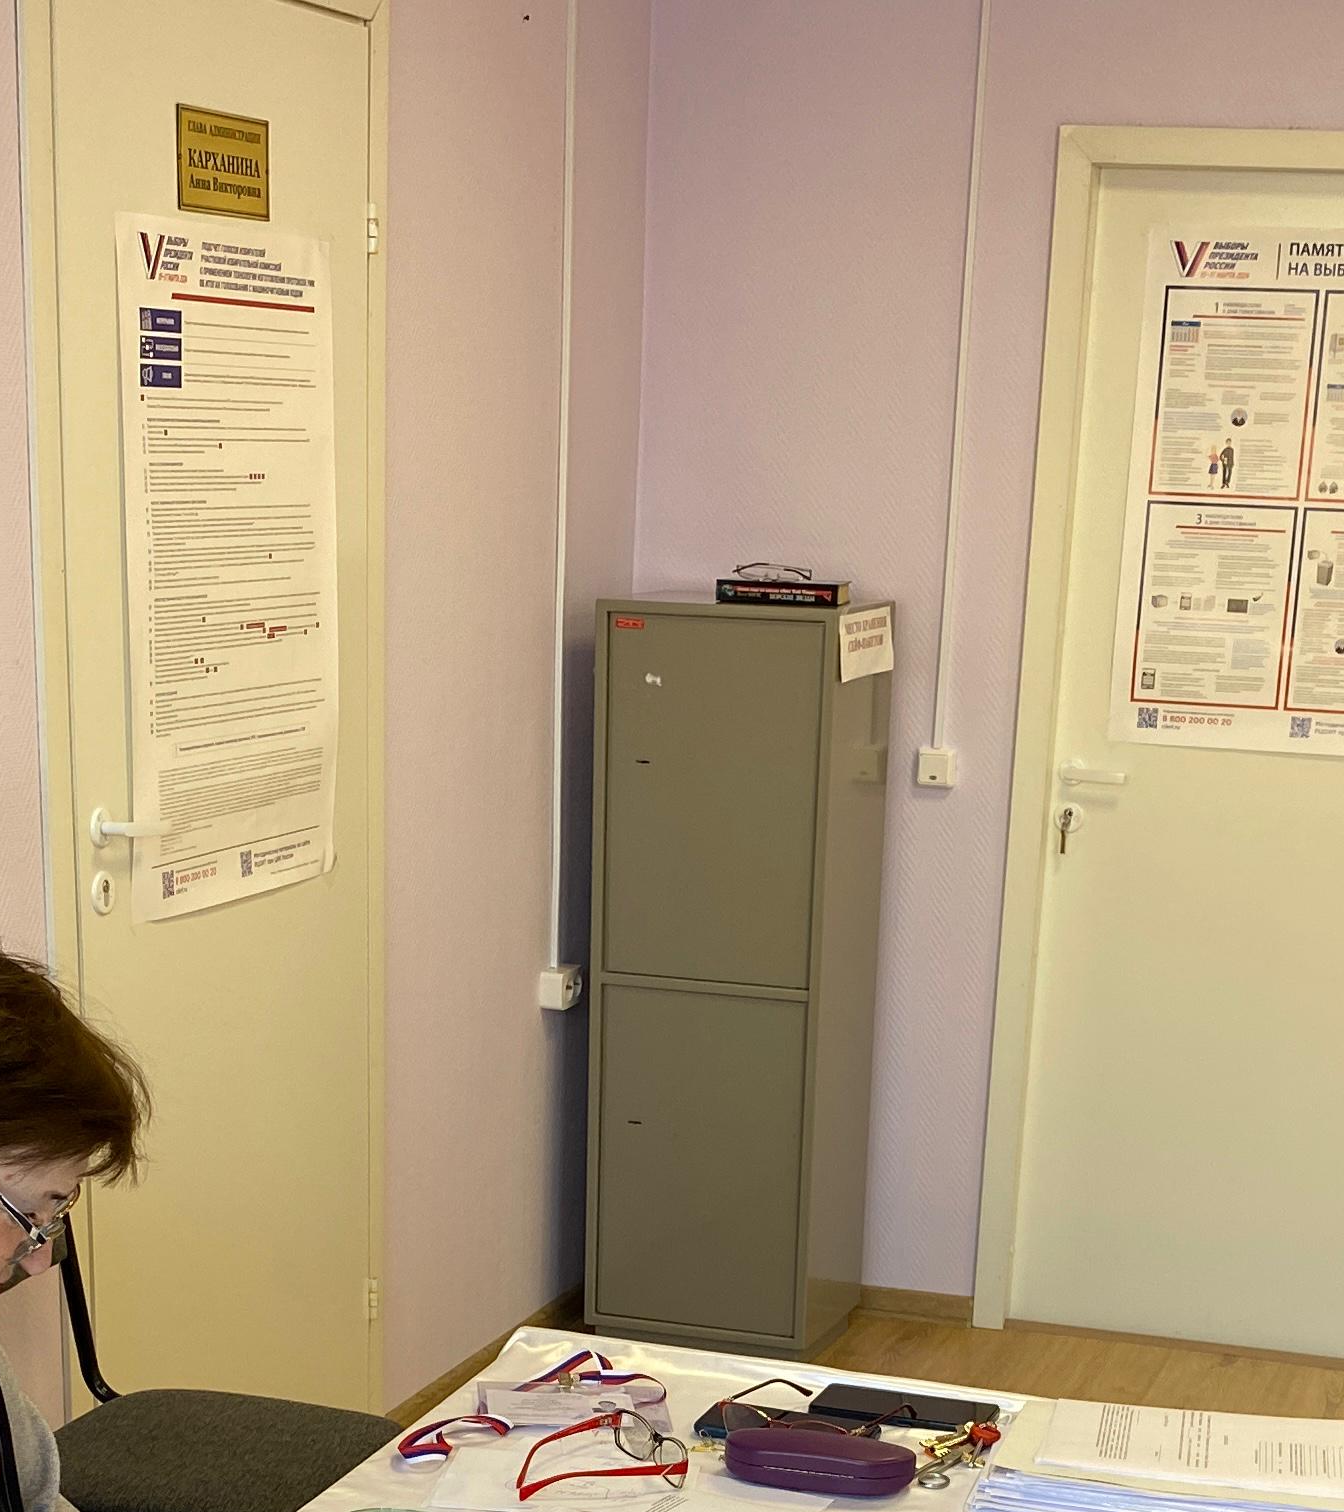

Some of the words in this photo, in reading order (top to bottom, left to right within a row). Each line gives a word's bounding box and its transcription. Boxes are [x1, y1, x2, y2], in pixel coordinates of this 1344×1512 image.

[188, 147, 261, 179] КАРХАНИНА
[189, 174, 211, 191] Анна
[213, 177, 262, 200] Викторовна
[1288, 262, 1310, 276] НА
[1195, 513, 1202, 525] 3
